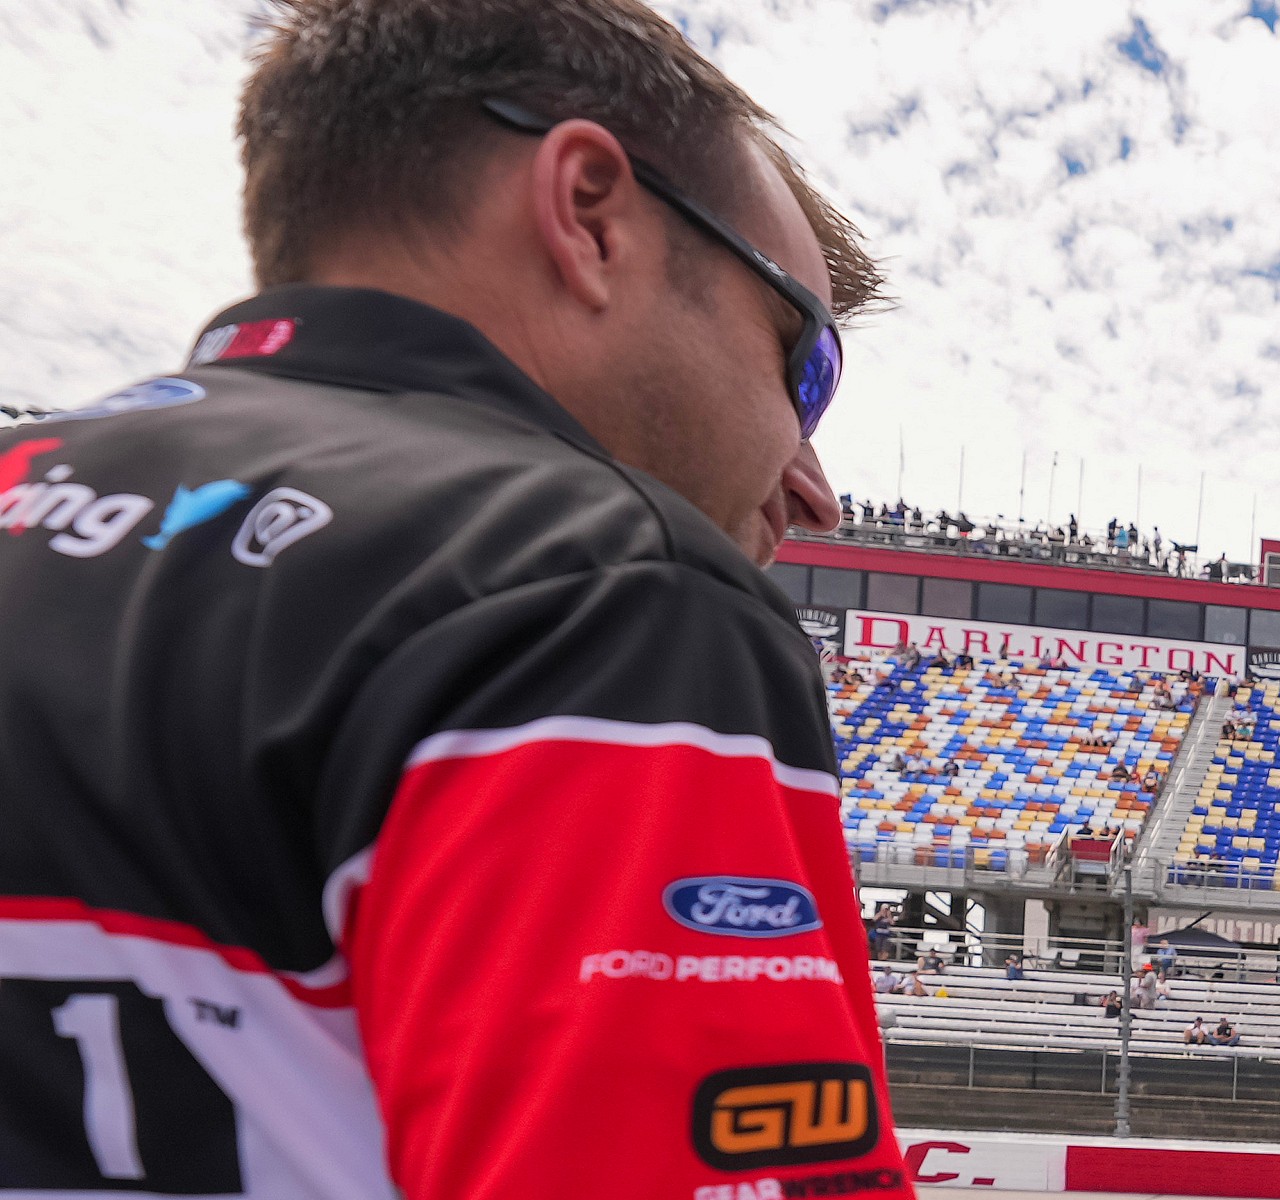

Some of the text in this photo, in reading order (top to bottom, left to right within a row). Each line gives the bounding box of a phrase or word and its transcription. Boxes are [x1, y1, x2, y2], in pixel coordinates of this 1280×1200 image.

[854, 615, 1236, 676] DARLINGTON
[688, 881, 801, 930] Ford
[579, 950, 673, 984] FORD
[50, 993, 147, 1180] 1
